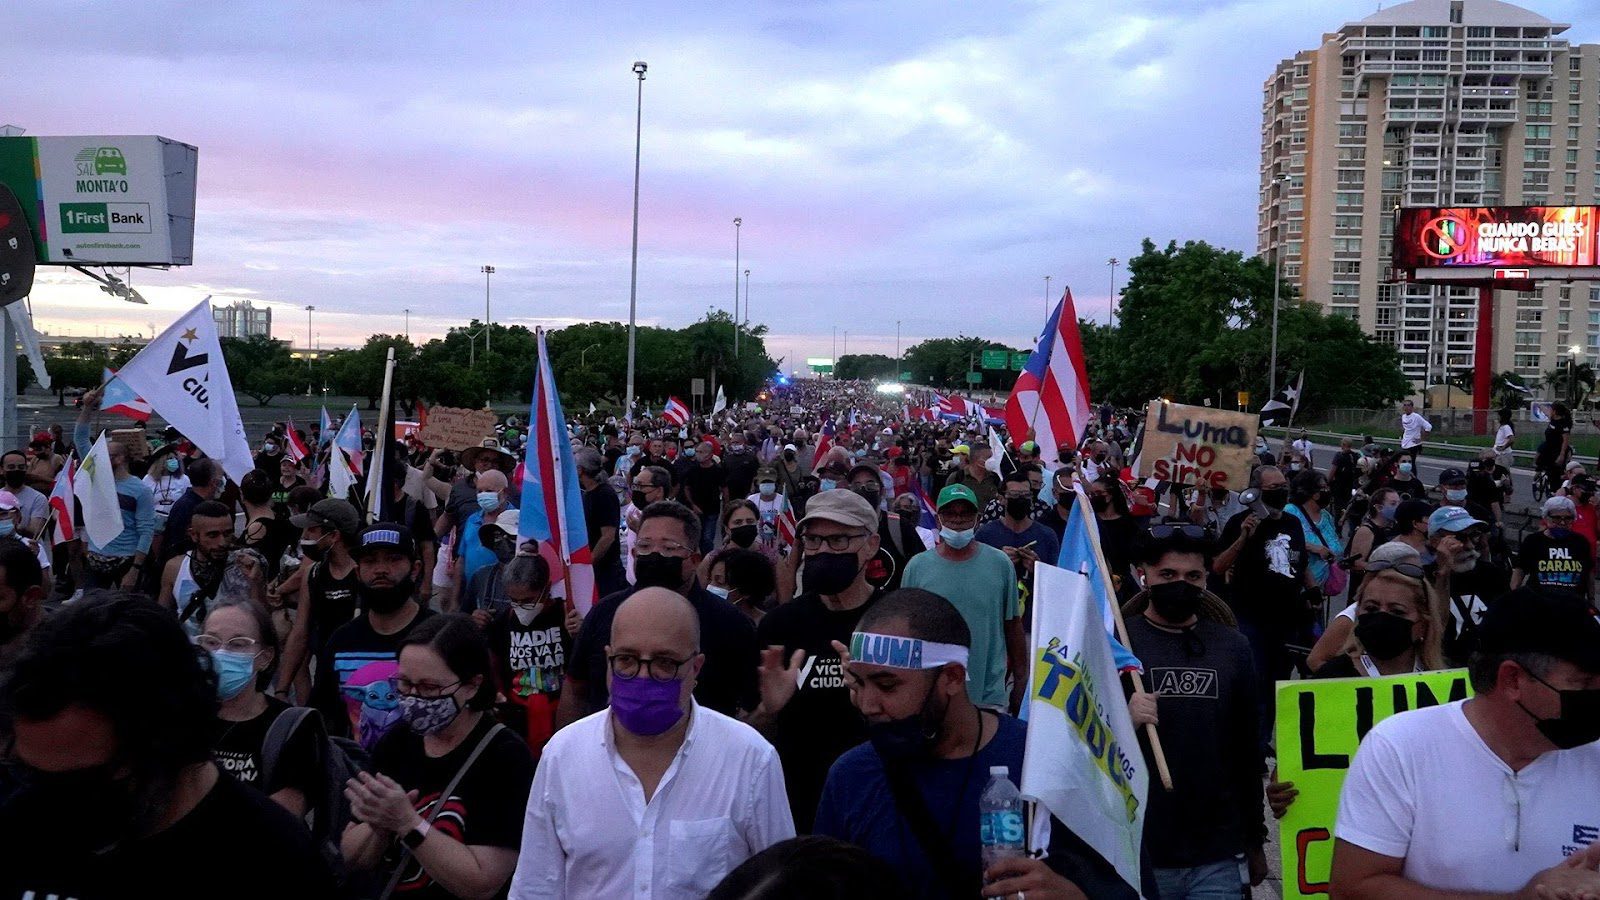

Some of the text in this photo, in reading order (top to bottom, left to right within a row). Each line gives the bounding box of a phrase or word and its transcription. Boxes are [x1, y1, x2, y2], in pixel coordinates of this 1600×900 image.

[77, 162, 95, 177] SAL
[111, 212, 144, 224] Bank
[1478, 222, 1540, 238] CUANDO
[1478, 237, 1577, 253] NUNCA BEBAS
[1157, 402, 1248, 448] Luma
[1175, 442, 1216, 468] NO
[1549, 547, 1572, 560] PAL
[1538, 560, 1583, 572] CARAJO
[509, 626, 562, 648] NADIE
[509, 642, 564, 659] NOS VA A
[863, 634, 922, 669] LUMA
[1158, 670, 1214, 695] A87
